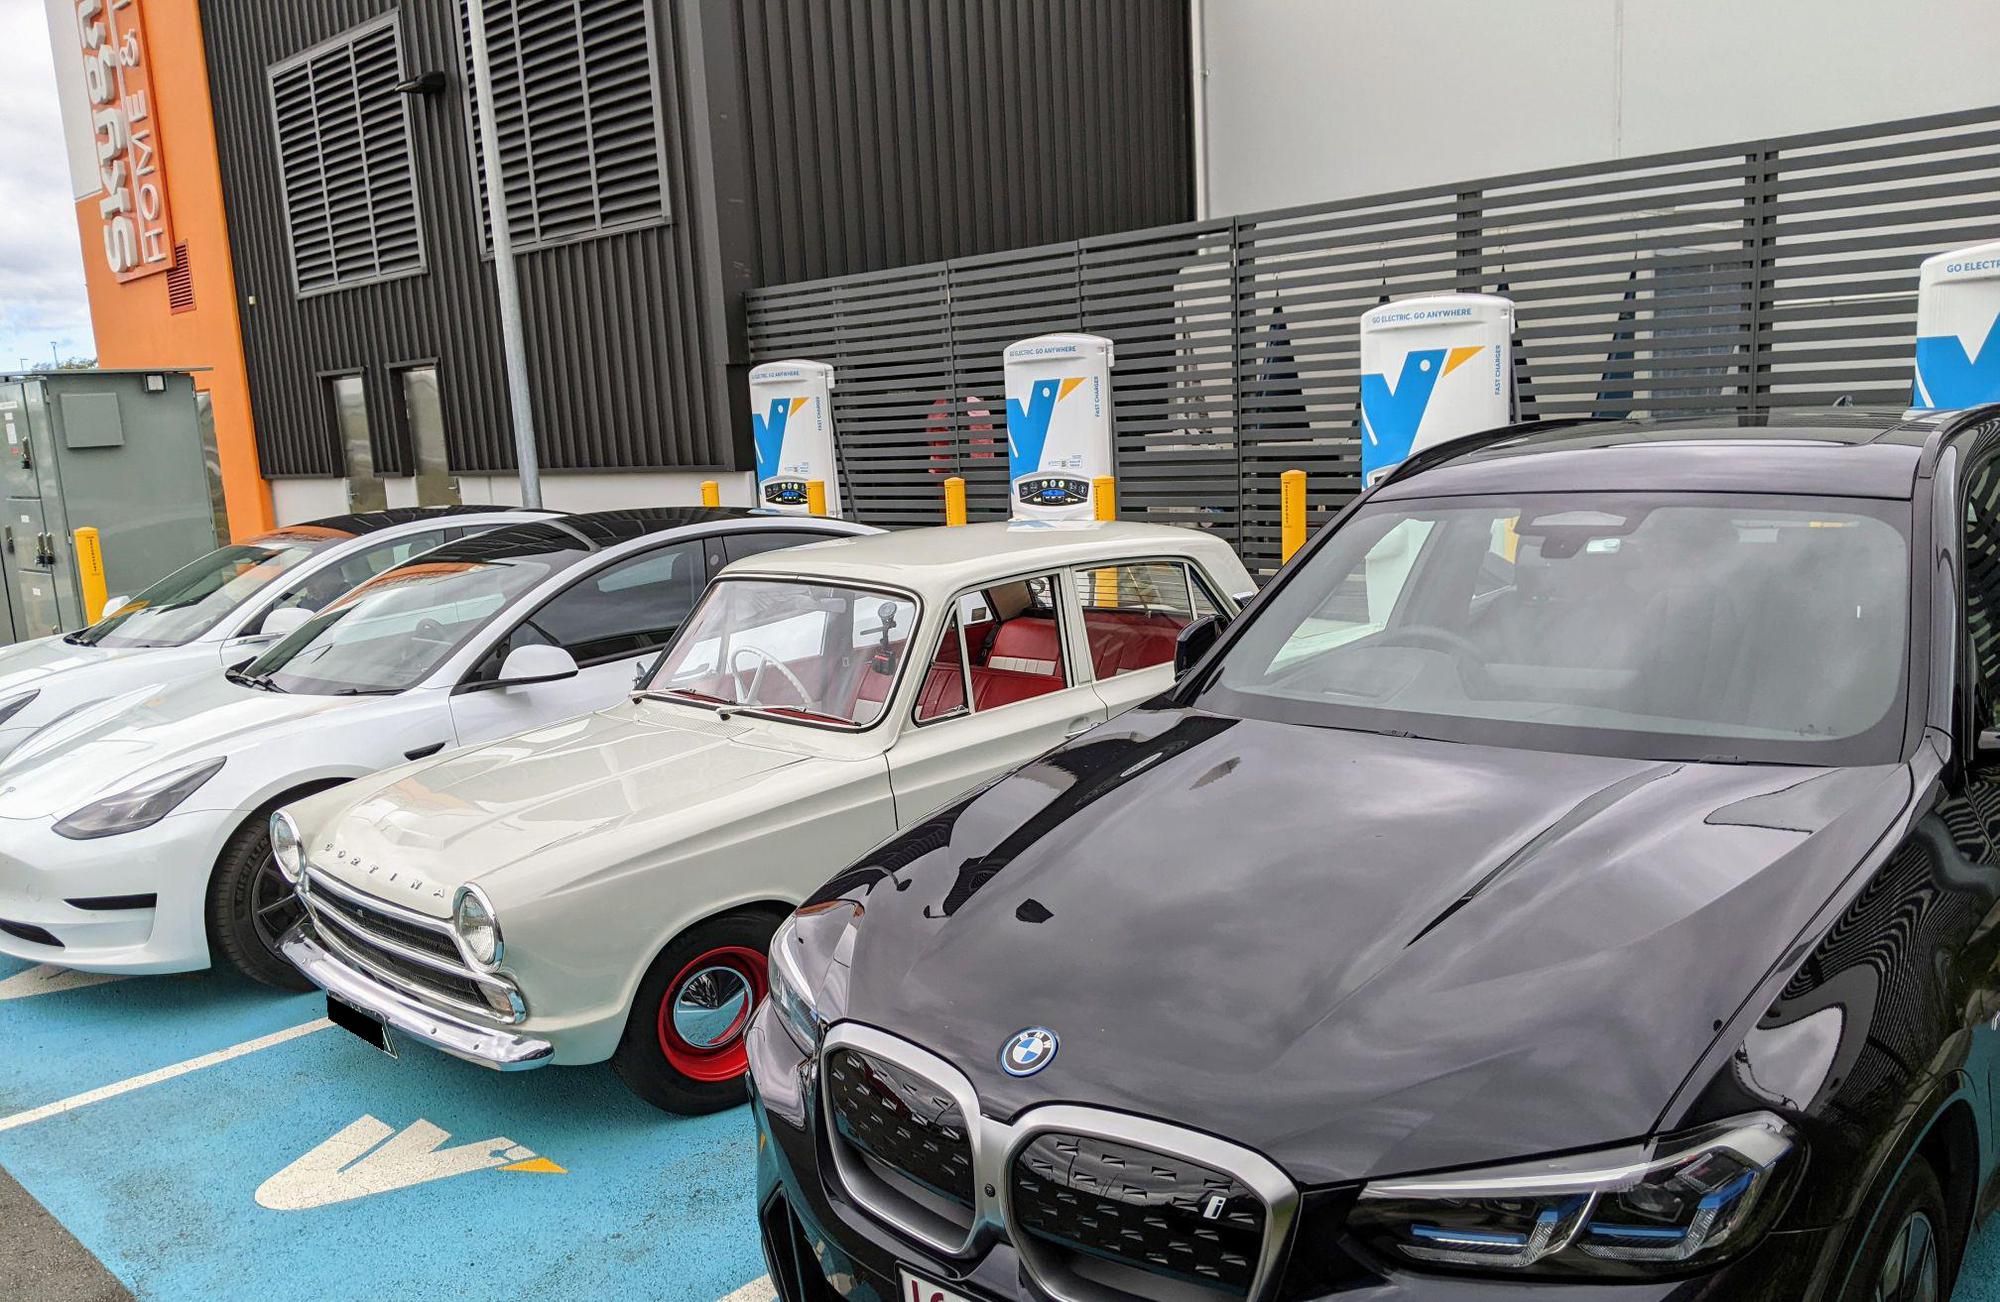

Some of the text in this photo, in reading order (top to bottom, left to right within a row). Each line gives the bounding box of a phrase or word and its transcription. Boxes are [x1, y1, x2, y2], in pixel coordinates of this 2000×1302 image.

[119, 28, 139, 67] &
[124, 89, 168, 264] HOME
[1946, 264, 1962, 273] GO
[1372, 316, 1381, 324] GO
[1413, 311, 1425, 320] GO
[1427, 307, 1472, 319] ANYWHERE
[1044, 345, 1077, 353] ANYWHERE
[324, 842, 445, 898] CORTINA
